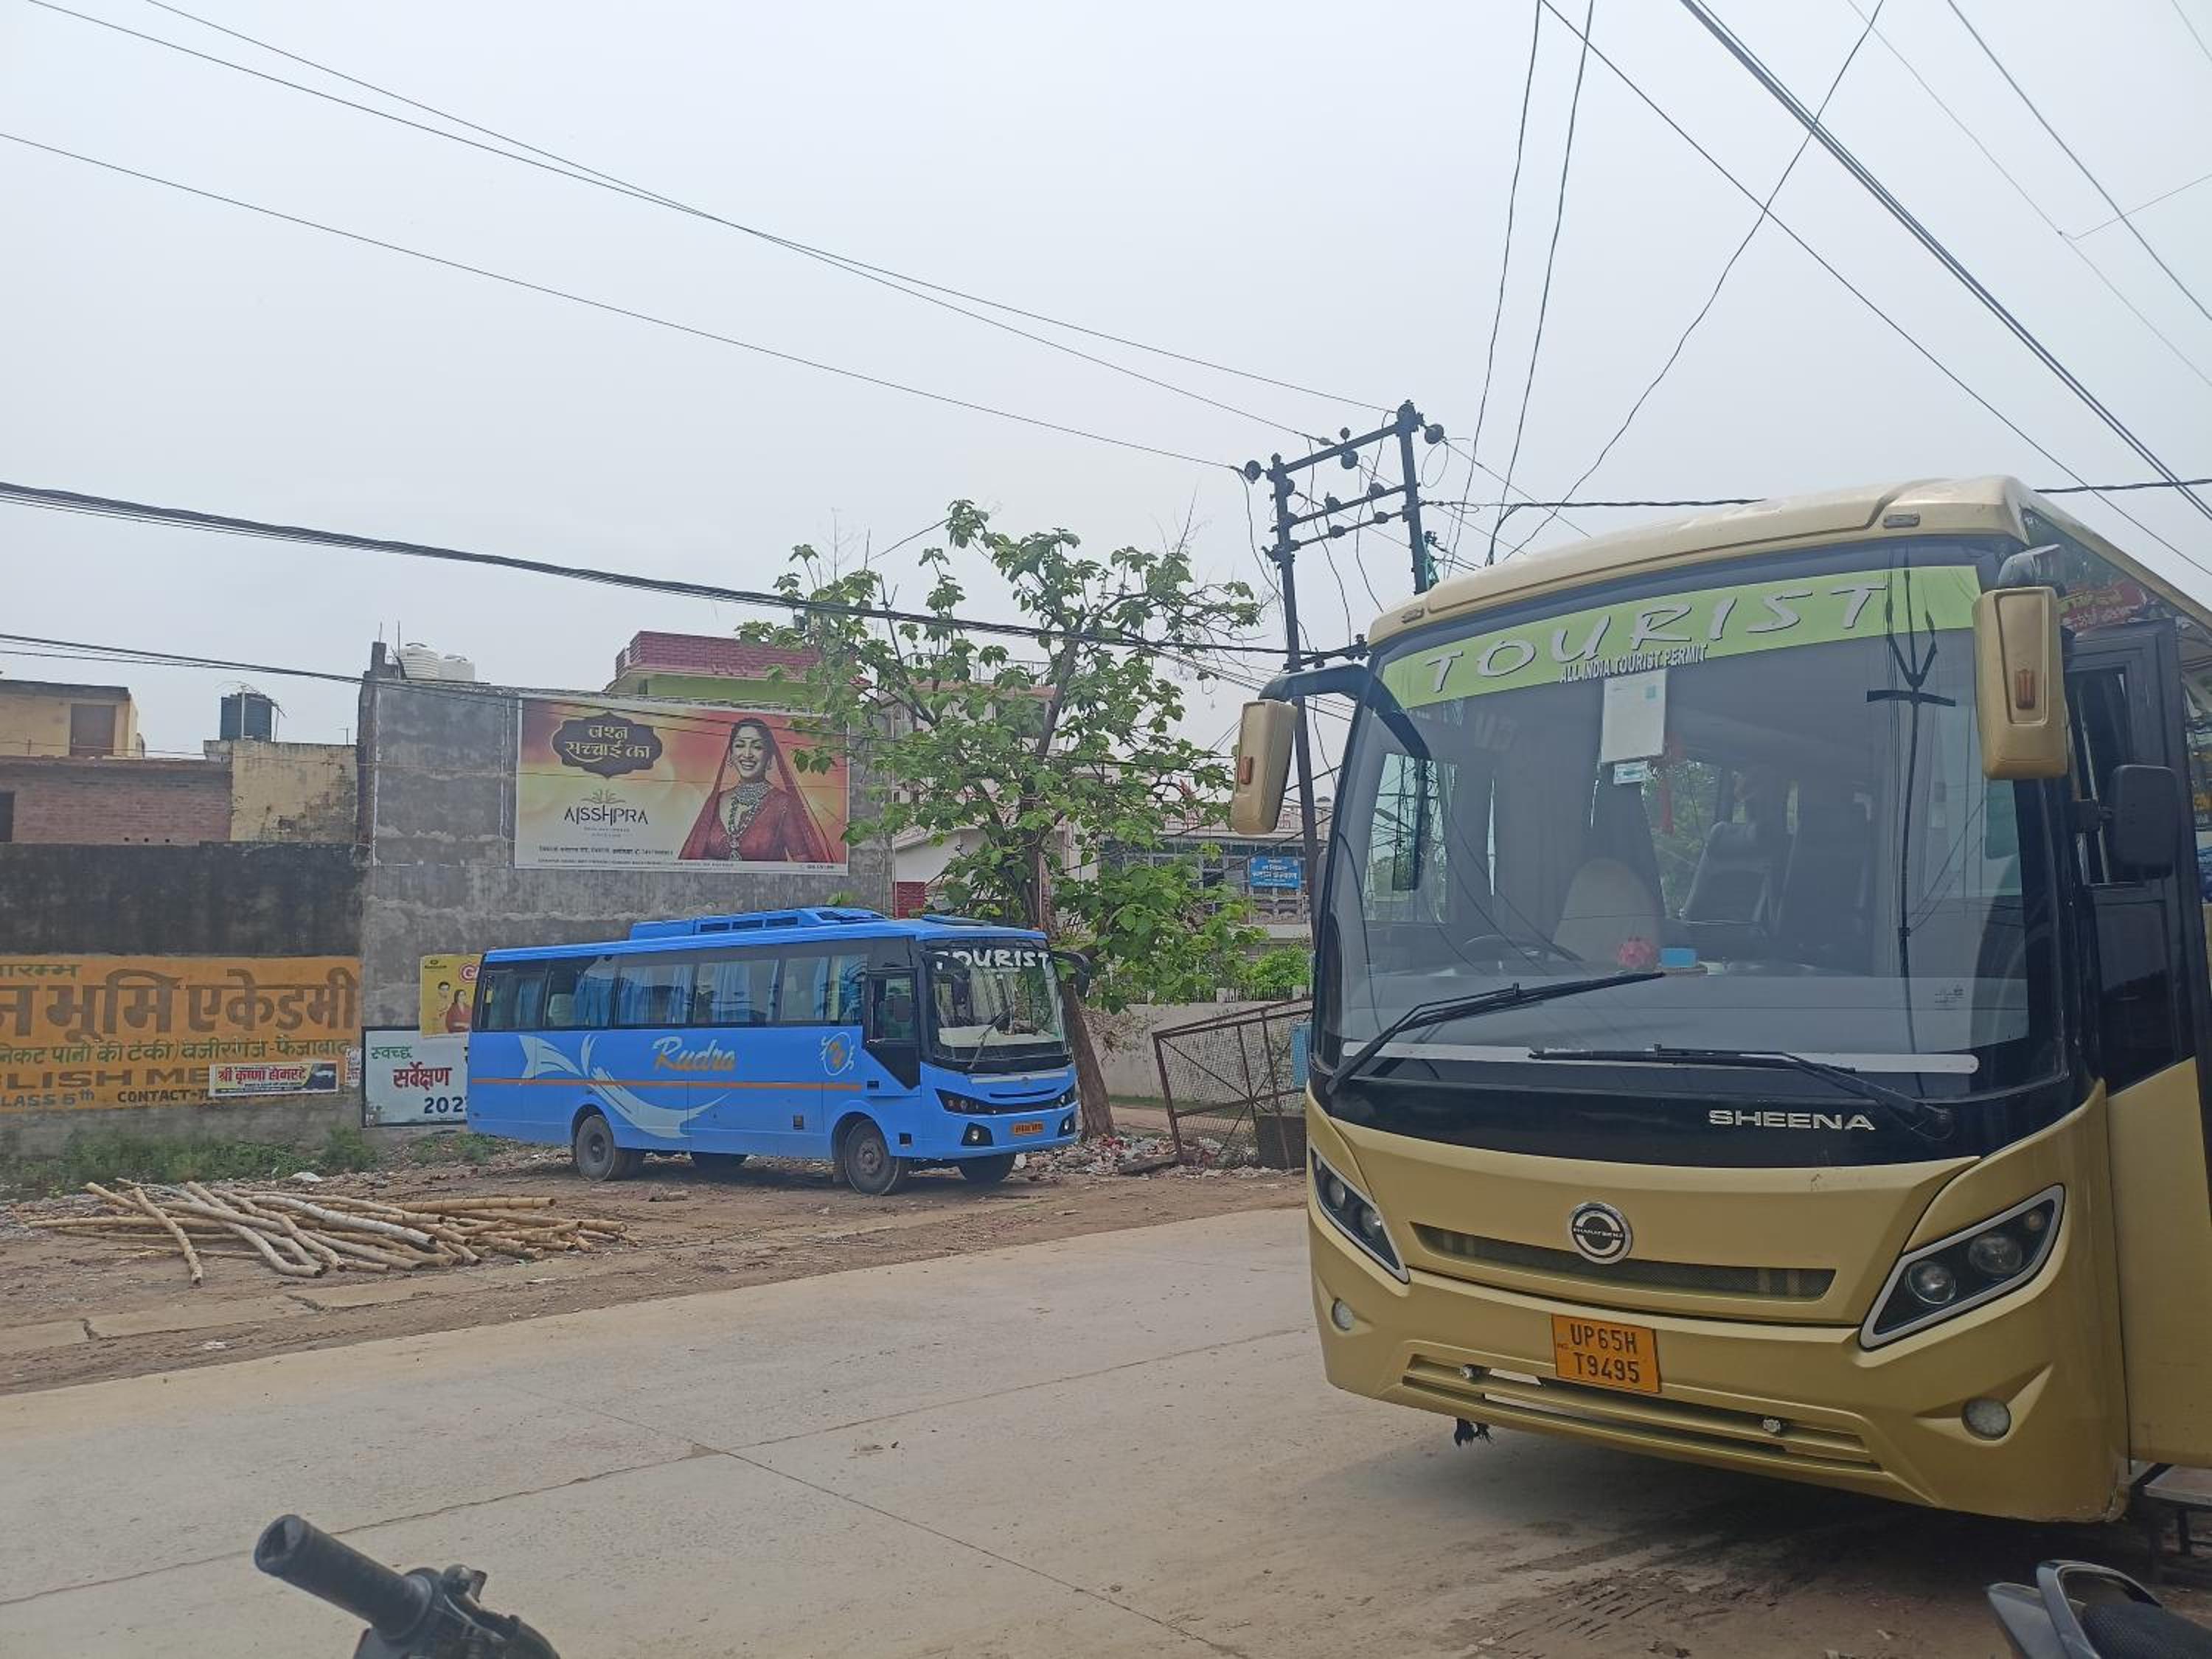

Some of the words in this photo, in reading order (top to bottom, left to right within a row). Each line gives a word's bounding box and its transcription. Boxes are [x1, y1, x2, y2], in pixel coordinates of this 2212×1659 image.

[1424, 583, 1888, 694] TOURIST
[1559, 665, 1581, 684] ALL
[1582, 658, 1610, 679] INDIA
[1614, 651, 1662, 675] TOURIST
[1665, 644, 1708, 667] PERMIT
[589, 725, 628, 740] जश्न
[566, 740, 623, 762] सच्चाई
[626, 745, 651, 759] का
[564, 804, 649, 826] AISSHPRA
[186, 967, 357, 1033] एकेडमी
[97, 1040, 125, 1062] की
[652, 1036, 736, 1072] Rudra
[0, 1069, 133, 1089] LISH
[218, 1067, 232, 1082] श्री
[392, 1061, 453, 1091] सर्वेक्षण
[0, 1093, 56, 1106] LASS
[424, 1096, 469, 1114] 202
[1708, 1109, 1877, 1131] SHEENA
[1570, 1324, 1638, 1354] UP65H
[1573, 1352, 1641, 1384] T9495
